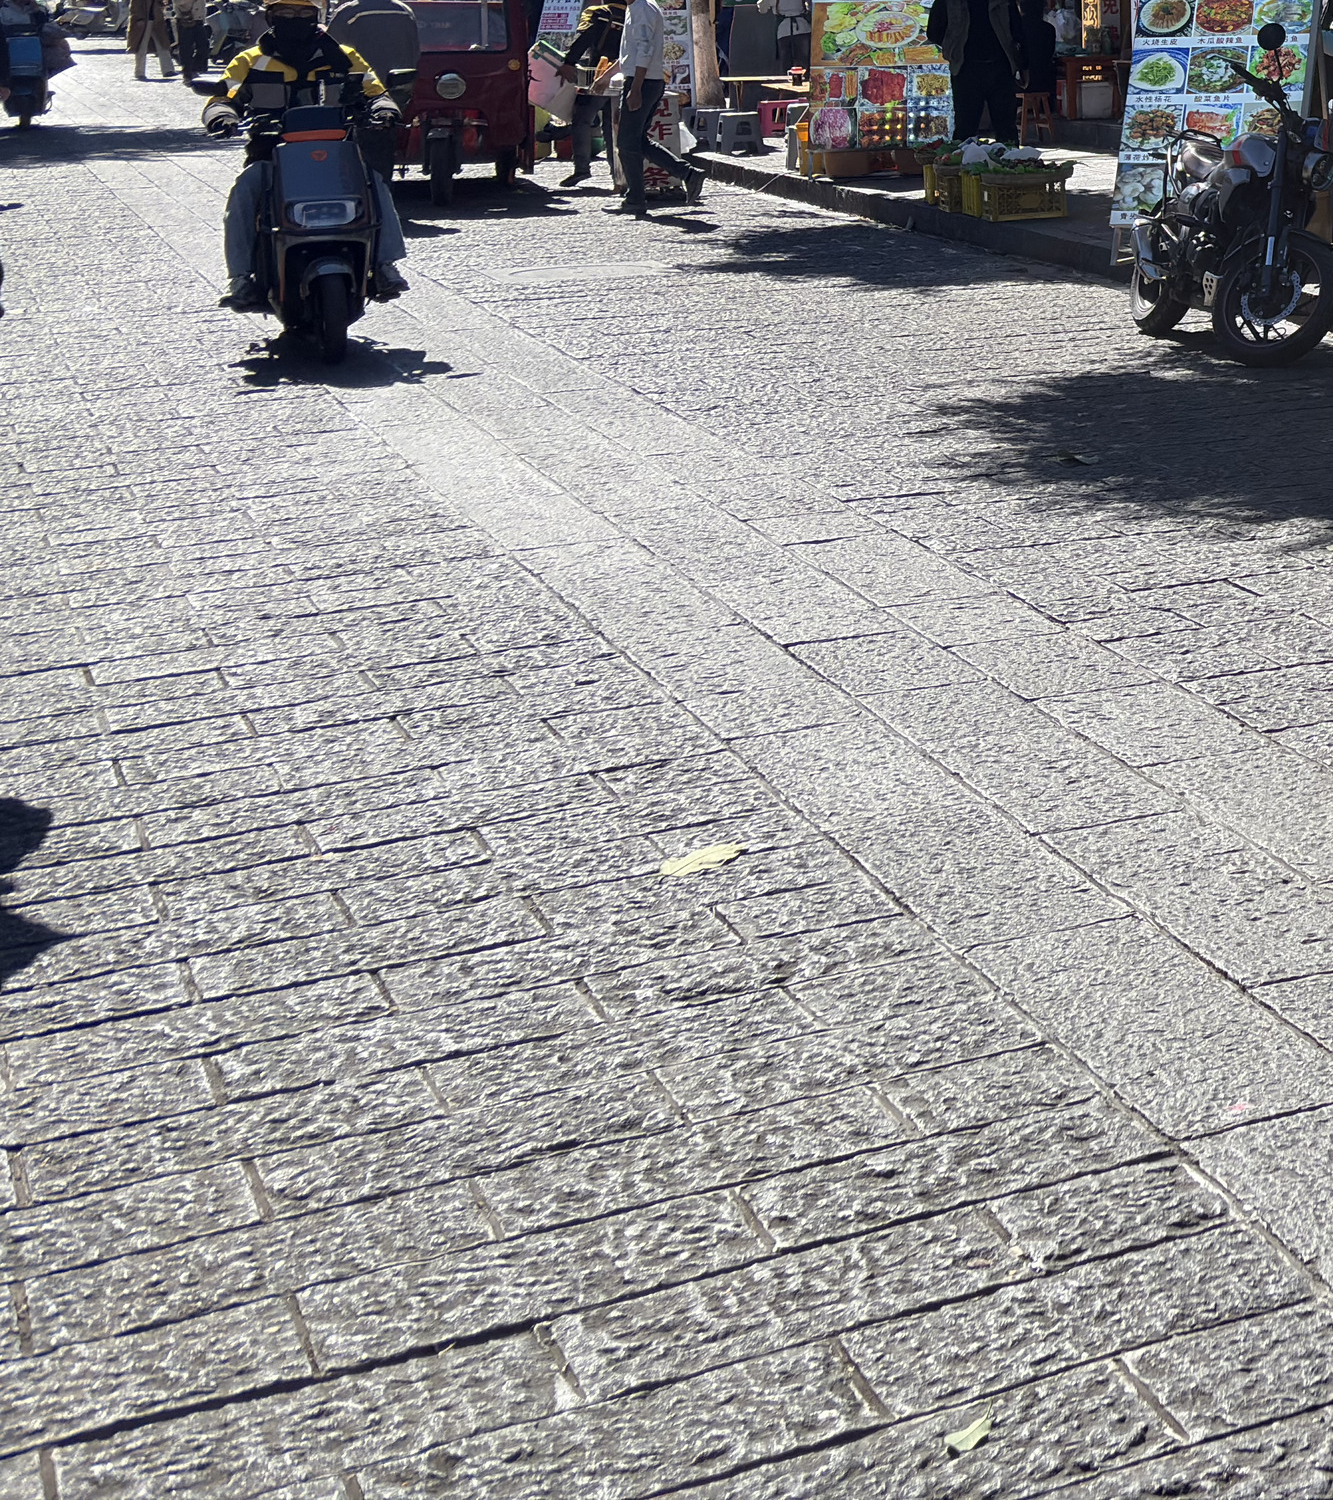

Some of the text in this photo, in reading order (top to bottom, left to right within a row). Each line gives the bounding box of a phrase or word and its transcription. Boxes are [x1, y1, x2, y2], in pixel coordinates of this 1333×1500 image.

[1142, 38, 1178, 46] 火烧生皮
[1196, 37, 1243, 45] 木瓜酸辣鱼
[1135, 95, 1172, 103] 水性杨花
[1193, 94, 1231, 103] 酸菜鱼片
